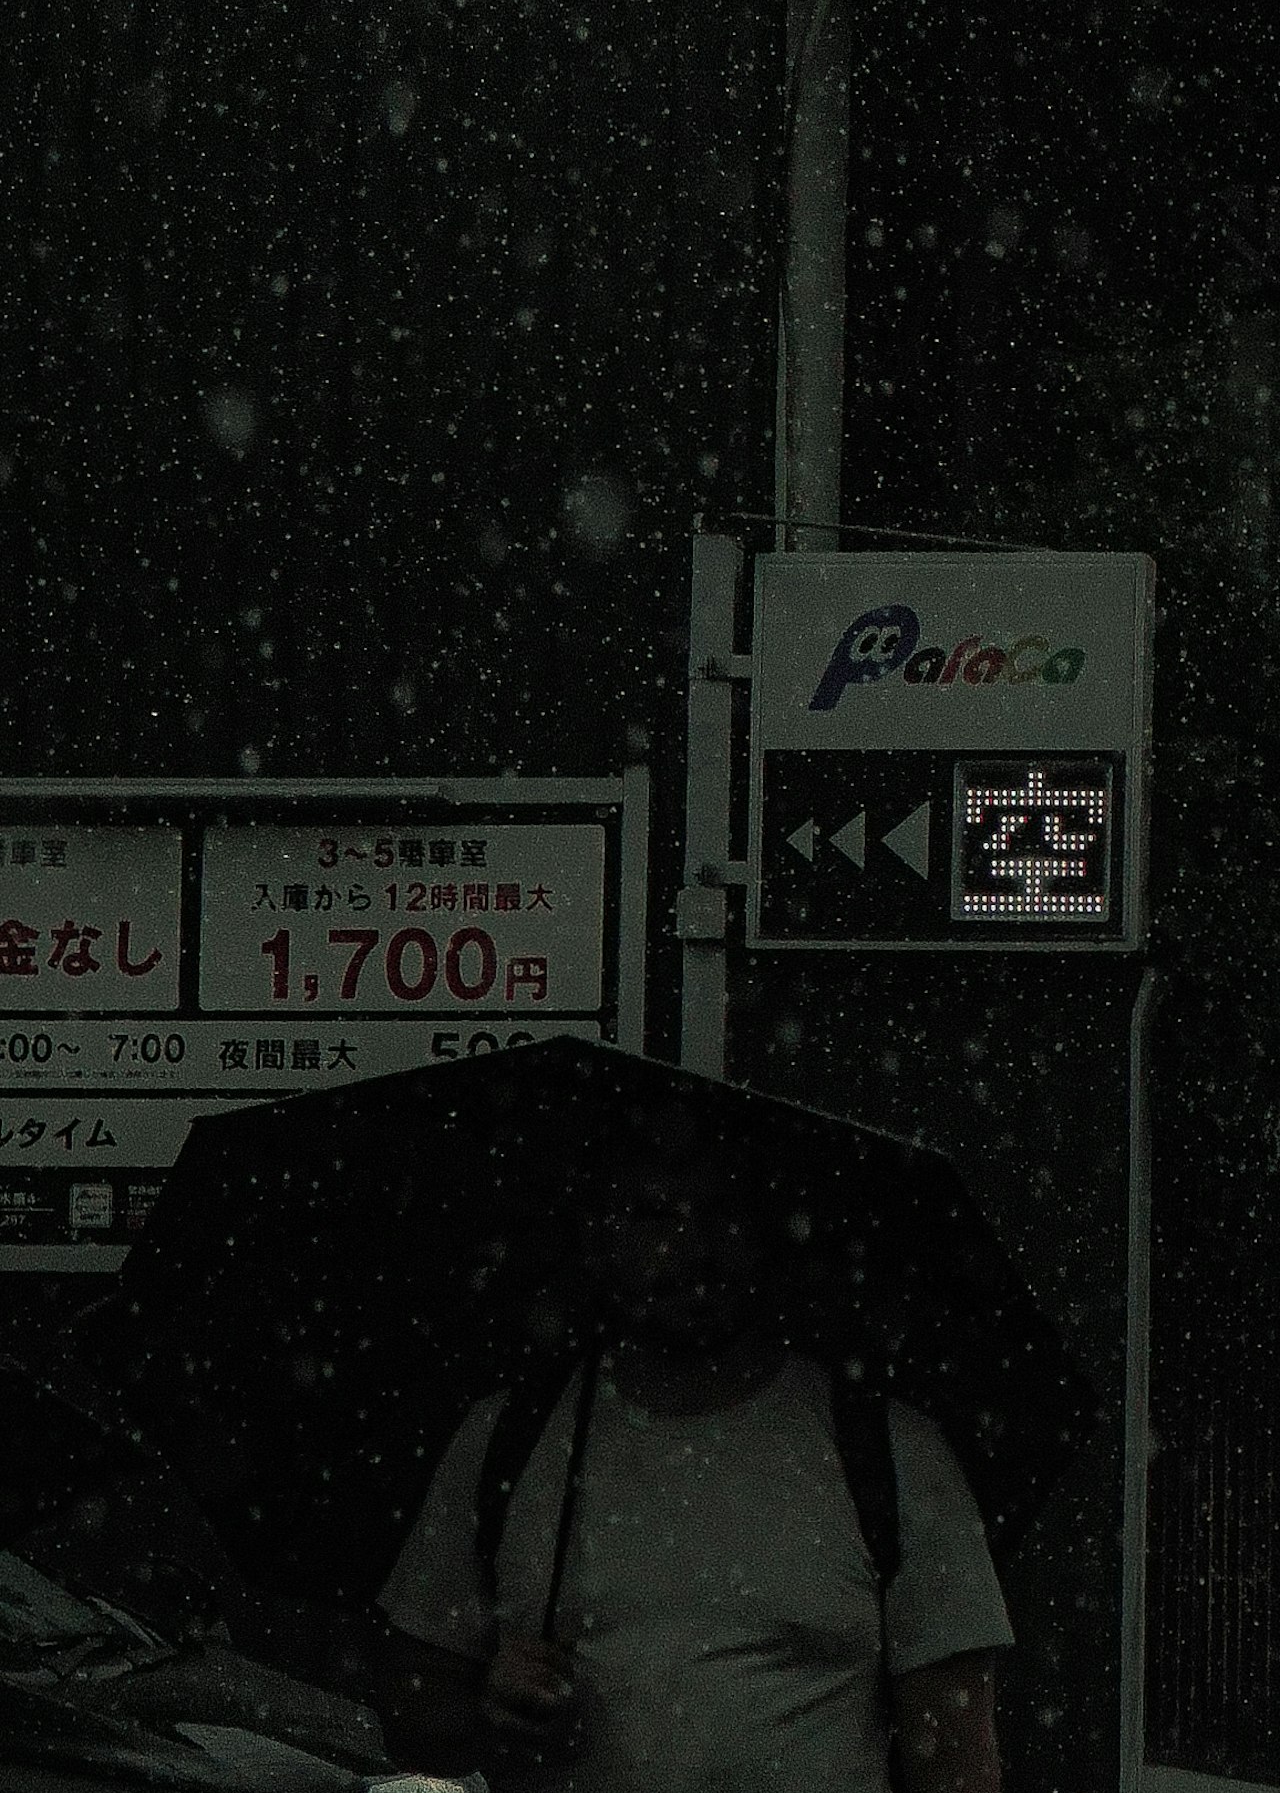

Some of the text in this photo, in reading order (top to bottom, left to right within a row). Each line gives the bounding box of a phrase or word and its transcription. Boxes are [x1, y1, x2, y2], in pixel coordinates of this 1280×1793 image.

[962, 770, 1105, 913] 空
[262, 926, 549, 1002] 1,700円
[108, 1034, 186, 1063] 7:00
[218, 1039, 358, 1072] 夜間最大
